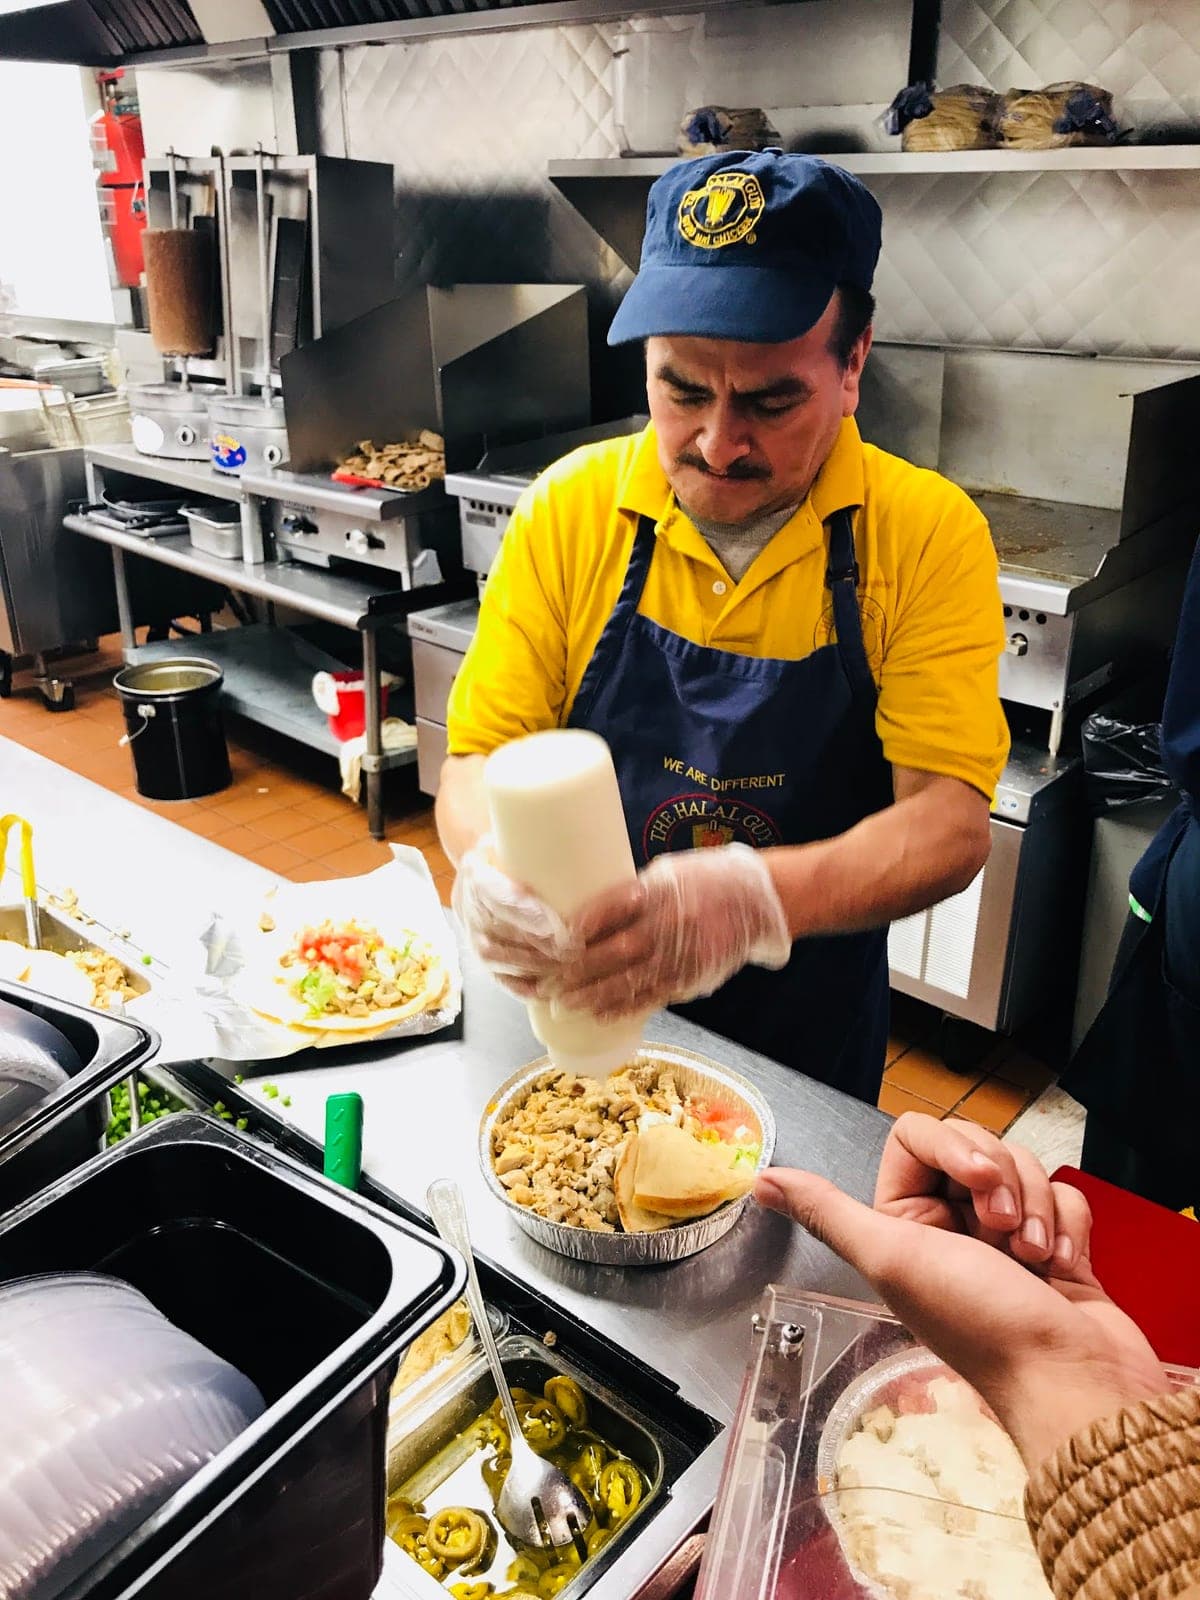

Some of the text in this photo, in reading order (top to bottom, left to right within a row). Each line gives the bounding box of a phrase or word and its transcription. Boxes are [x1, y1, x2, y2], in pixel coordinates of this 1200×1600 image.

[663, 756, 786, 791] WE ARE DIFFERENT
[650, 800, 776, 846] THE HALAL GUY
